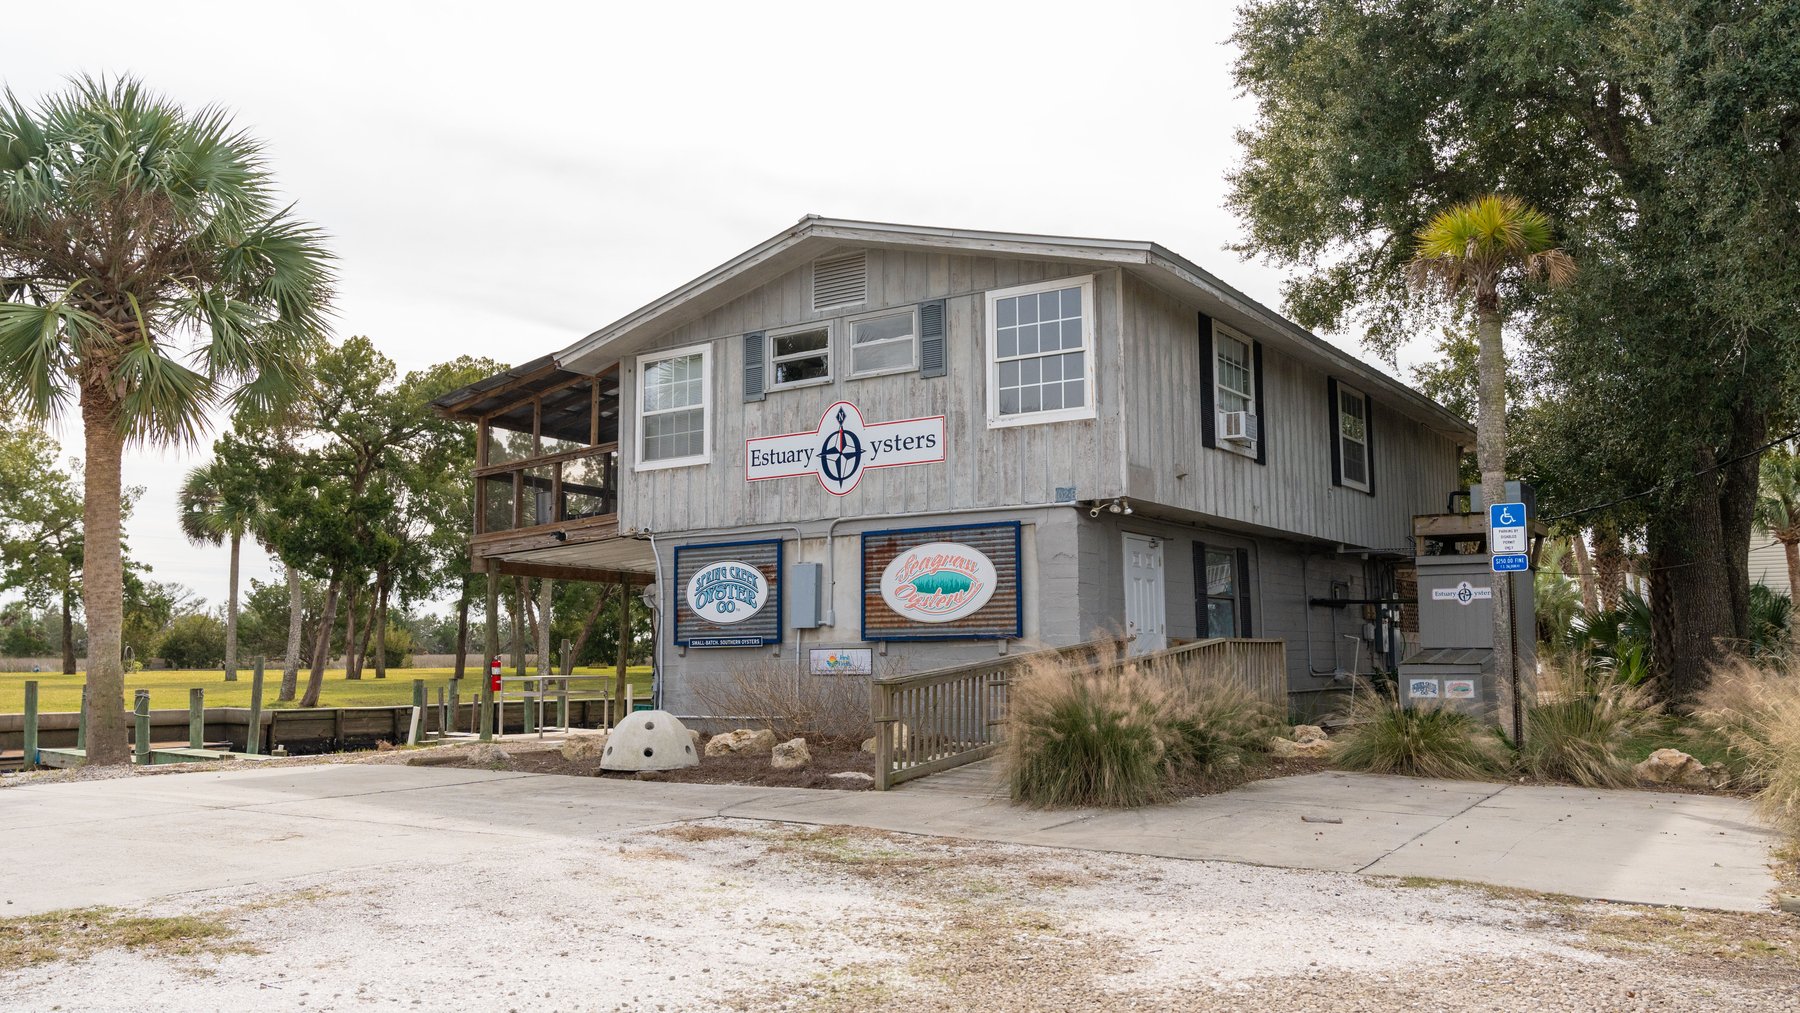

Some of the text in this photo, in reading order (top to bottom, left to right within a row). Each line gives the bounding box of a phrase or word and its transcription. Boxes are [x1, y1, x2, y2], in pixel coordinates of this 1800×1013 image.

[750, 447, 815, 468] Estuary
[696, 566, 759, 591] SPRING CREEK
[895, 554, 979, 584] Seagrass
[695, 583, 758, 610] OYSTER
[894, 582, 983, 614] Oysters
[1434, 591, 1457, 599] Estuary
